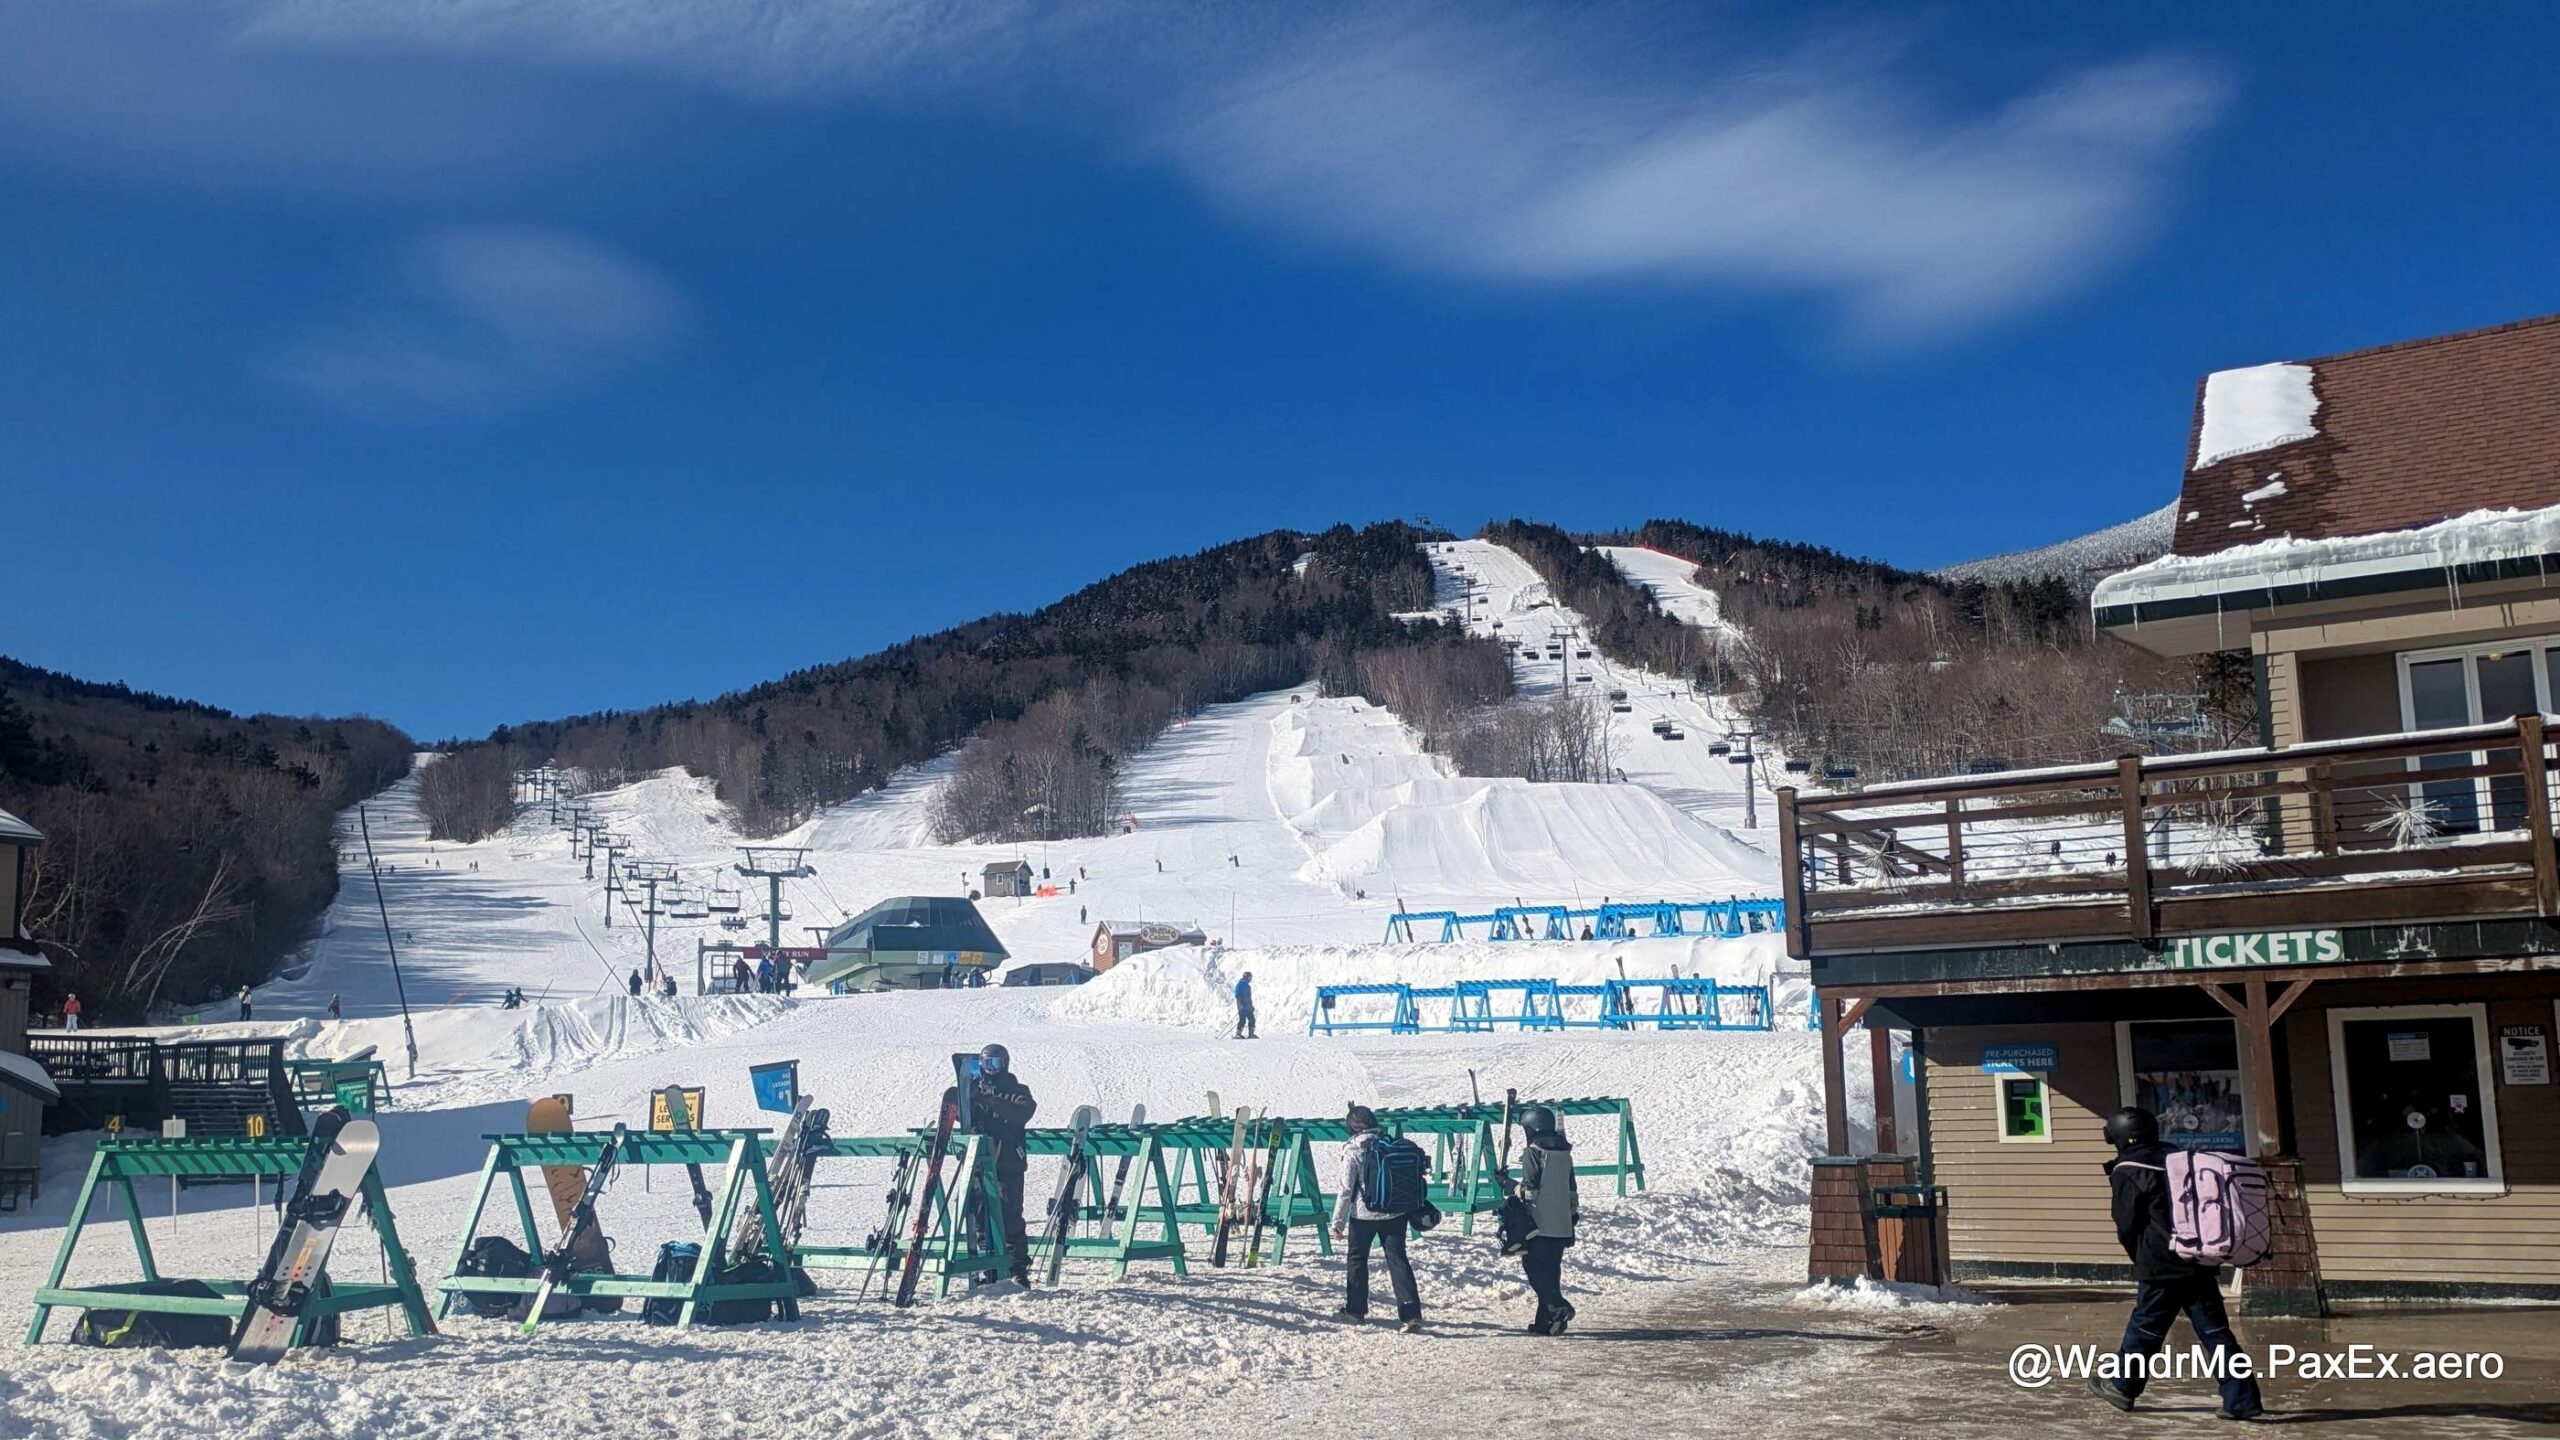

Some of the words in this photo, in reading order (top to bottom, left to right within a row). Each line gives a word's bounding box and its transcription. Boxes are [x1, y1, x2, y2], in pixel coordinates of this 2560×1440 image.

[792, 950, 810, 958] RUN
[2168, 930, 2341, 968] TICKETS
[2503, 1026, 2541, 1036] NOTICE
[1985, 1048, 2054, 1057] PRE-PURCHASED
[1986, 1058, 2025, 1067] TICKETS
[2027, 1058, 2054, 1066] HERE
[778, 1089, 792, 1107] #1
[107, 1115, 120, 1132] 4
[656, 1114, 695, 1124] SERS
[247, 1115, 264, 1137] 10
